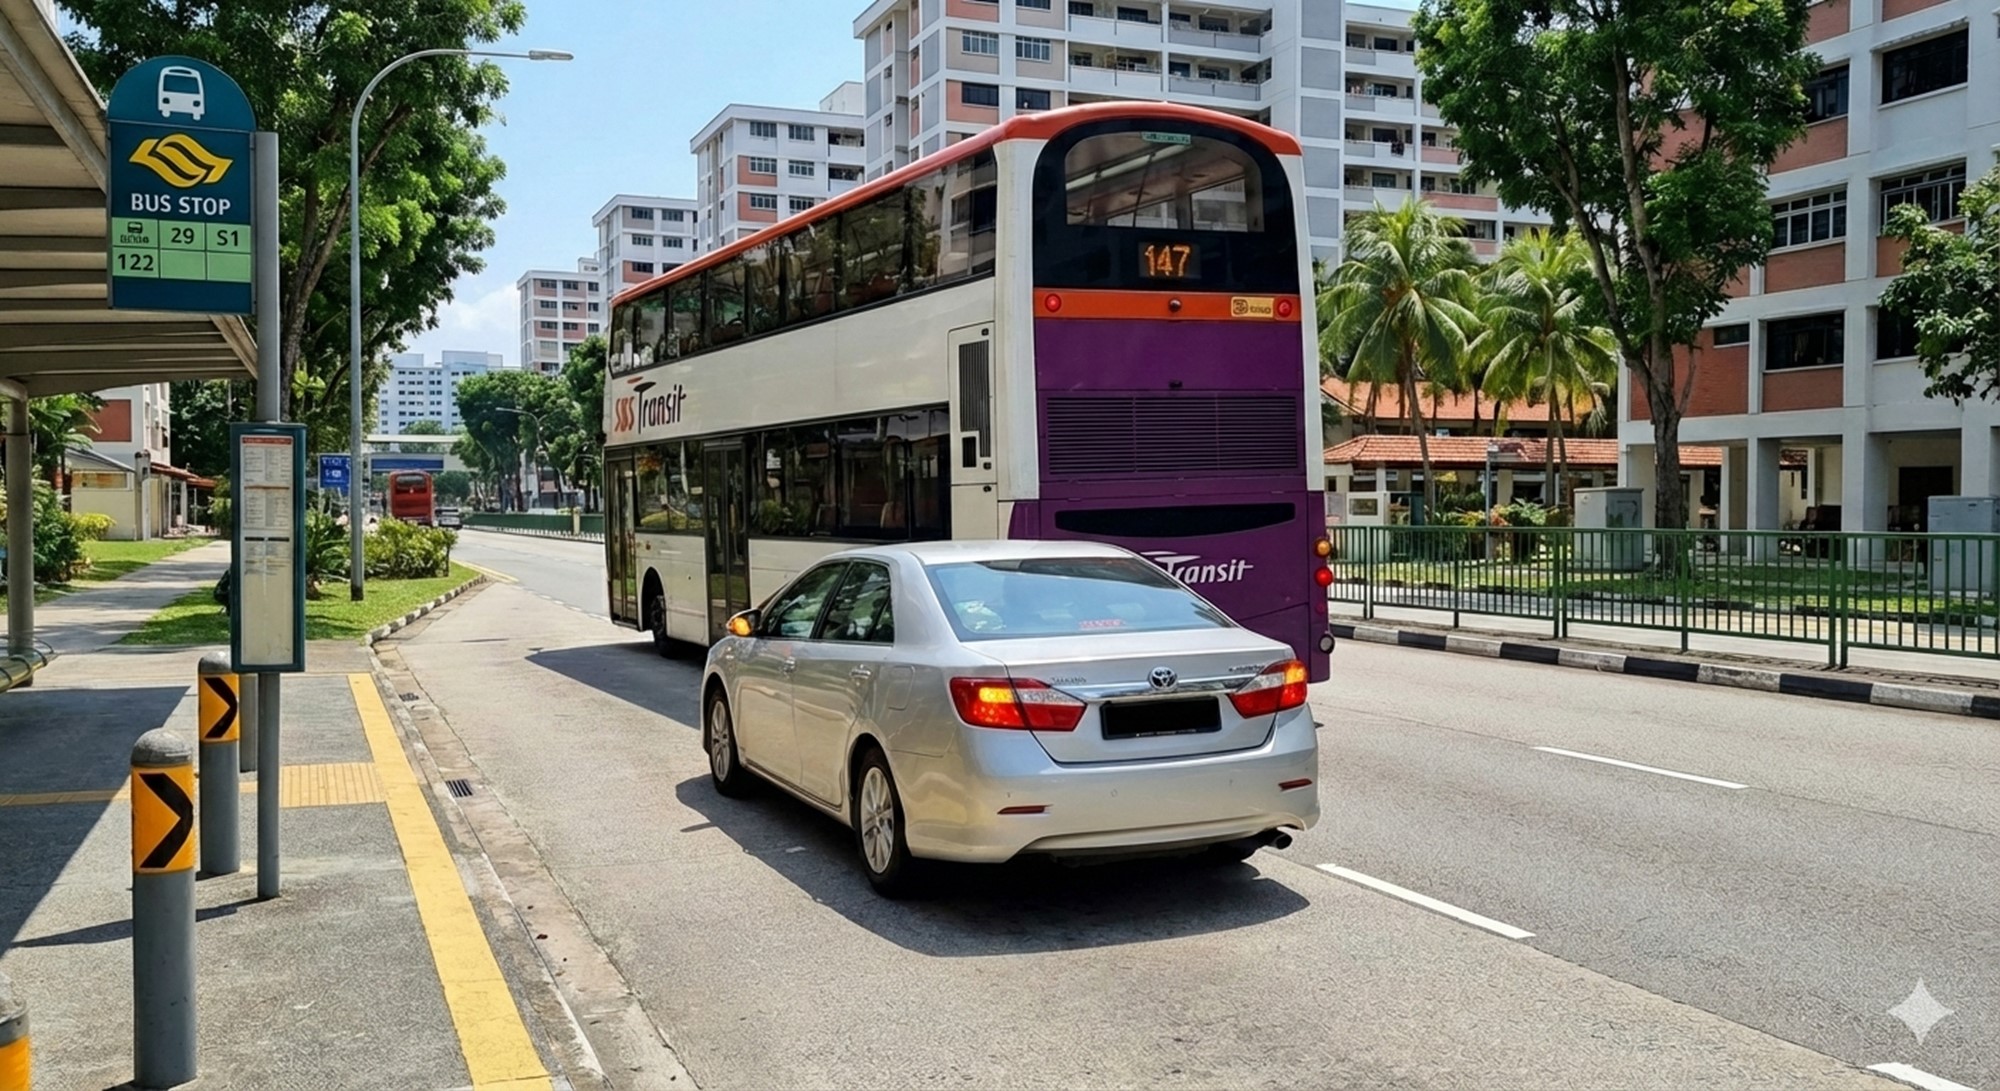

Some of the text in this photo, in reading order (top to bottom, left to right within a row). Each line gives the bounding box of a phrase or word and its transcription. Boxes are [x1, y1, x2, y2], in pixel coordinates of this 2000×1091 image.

[131, 193, 231, 216] BUS STOP
[171, 227, 195, 245] 29
[216, 229, 239, 247] S1
[117, 254, 154, 272] 122
[1144, 244, 1191, 277] 147
[633, 381, 687, 435] Transit
